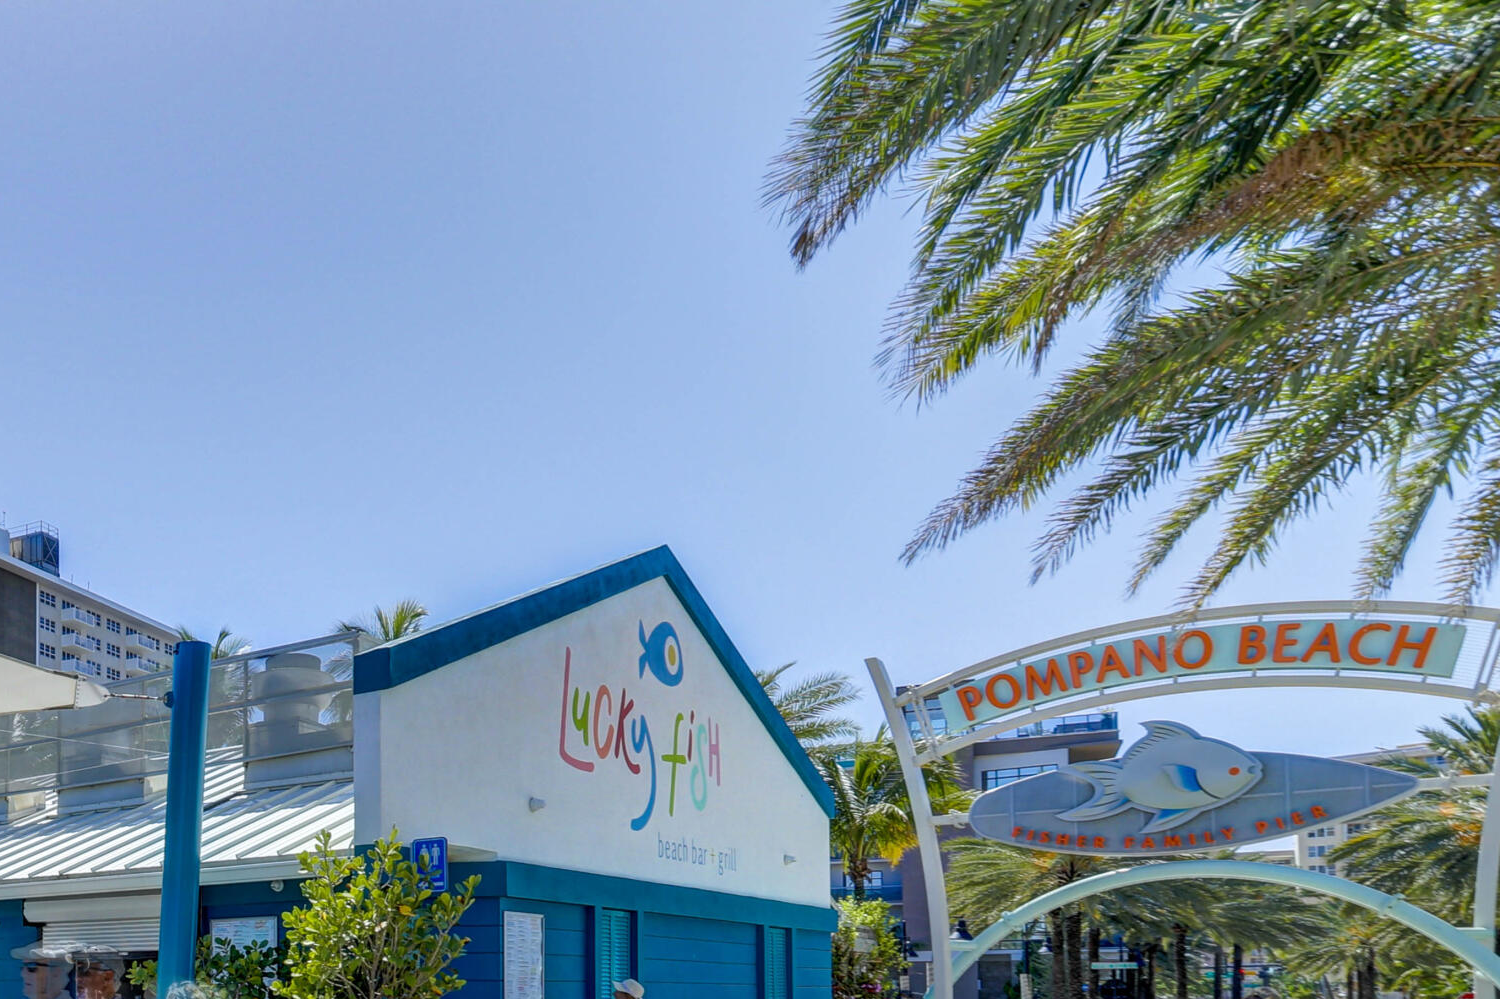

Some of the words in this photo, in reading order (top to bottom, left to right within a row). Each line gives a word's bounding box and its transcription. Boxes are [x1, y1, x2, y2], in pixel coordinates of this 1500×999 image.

[956, 630, 1214, 721] POMPANO
[1237, 622, 1438, 668] BEACH
[1011, 826, 1106, 849] FISHER
[1124, 826, 1236, 849] FAMILY
[1255, 805, 1329, 835] PIER
[657, 832, 688, 862] beach
[691, 837, 708, 865] bar
[718, 847, 737, 876] grill
